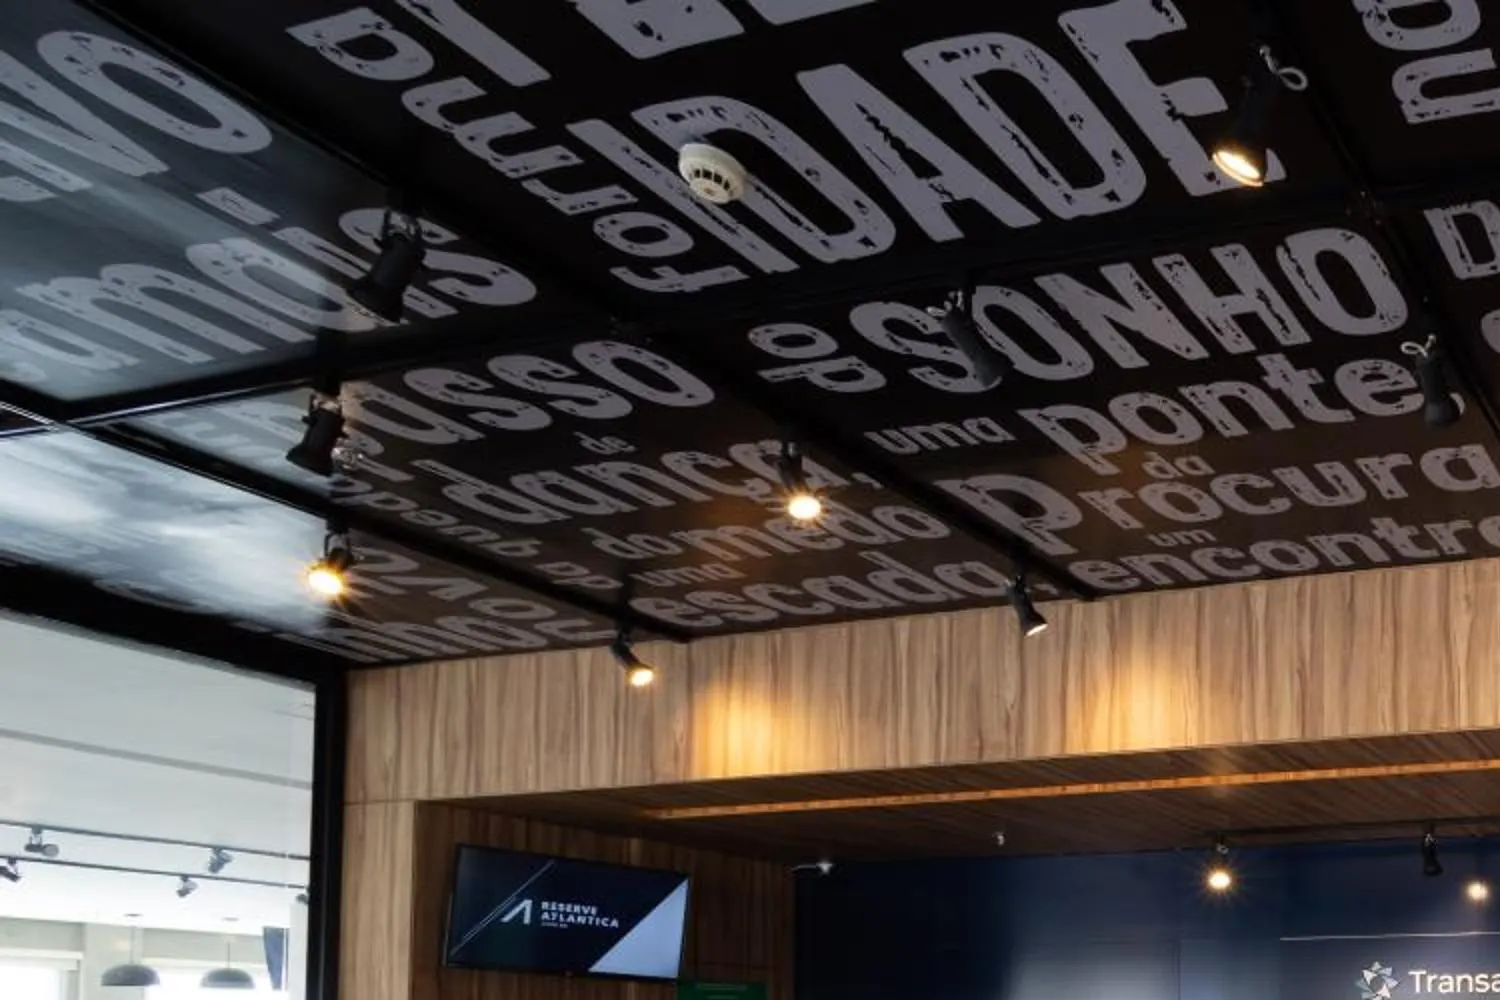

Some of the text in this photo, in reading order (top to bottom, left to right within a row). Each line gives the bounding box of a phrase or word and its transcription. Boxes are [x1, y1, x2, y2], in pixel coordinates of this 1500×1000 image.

[747, 227, 1408, 394] do SONHO
[863, 416, 1015, 454] uma
[1140, 449, 1216, 479] da
[581, 527, 685, 560] do
[1149, 529, 1218, 549] um
[629, 559, 749, 589] uma
